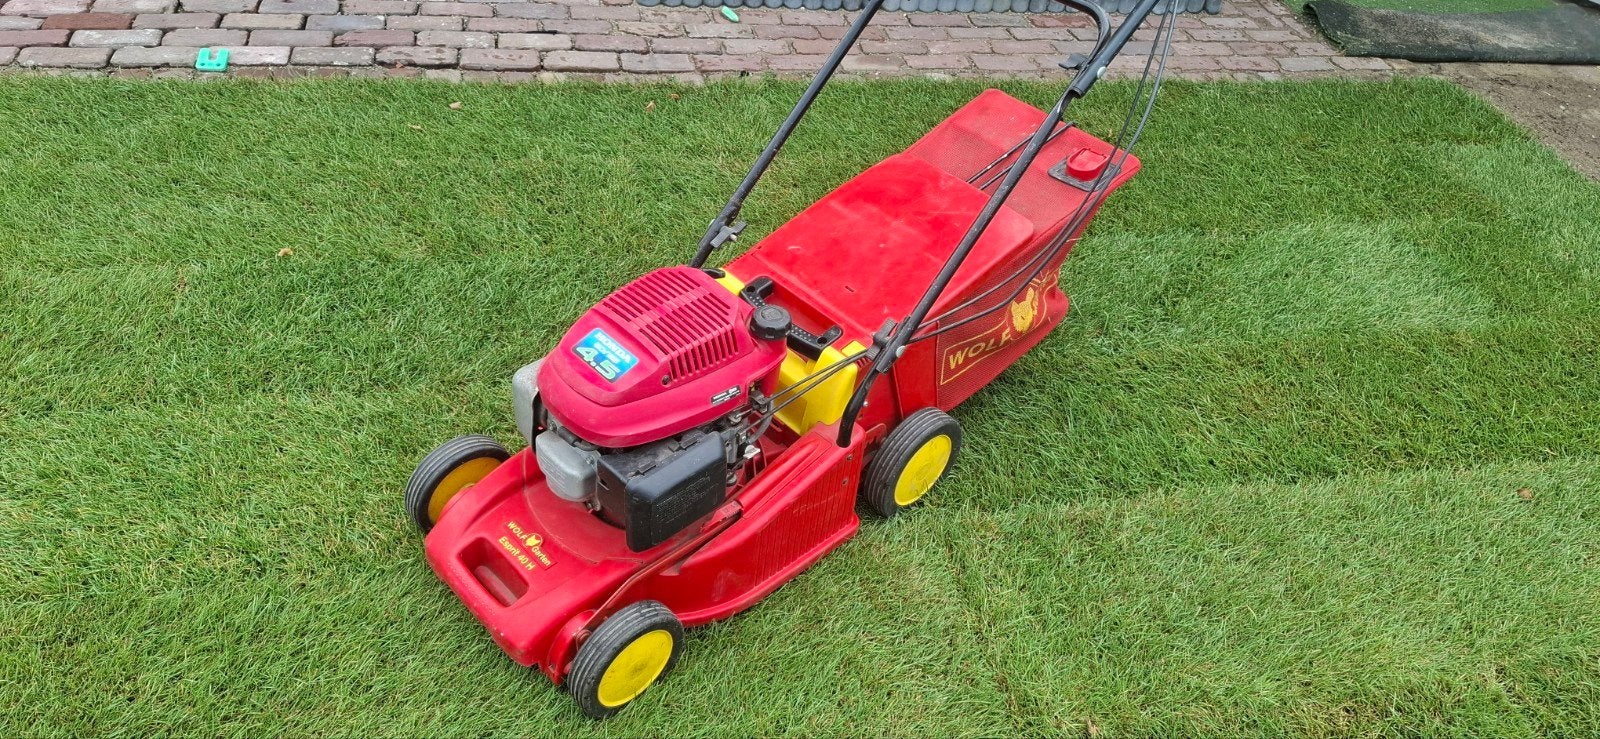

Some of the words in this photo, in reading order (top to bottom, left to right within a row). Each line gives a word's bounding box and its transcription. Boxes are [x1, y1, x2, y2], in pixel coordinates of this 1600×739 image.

[576, 347, 620, 379] 4.5
[594, 332, 630, 364] HONDA
[949, 328, 1011, 369] WOLF
[498, 536, 520, 556] Esprit
[518, 554, 529, 564] 40
[525, 562, 536, 570] H
[507, 521, 527, 539] WOLF
[531, 546, 551, 566] Garten
